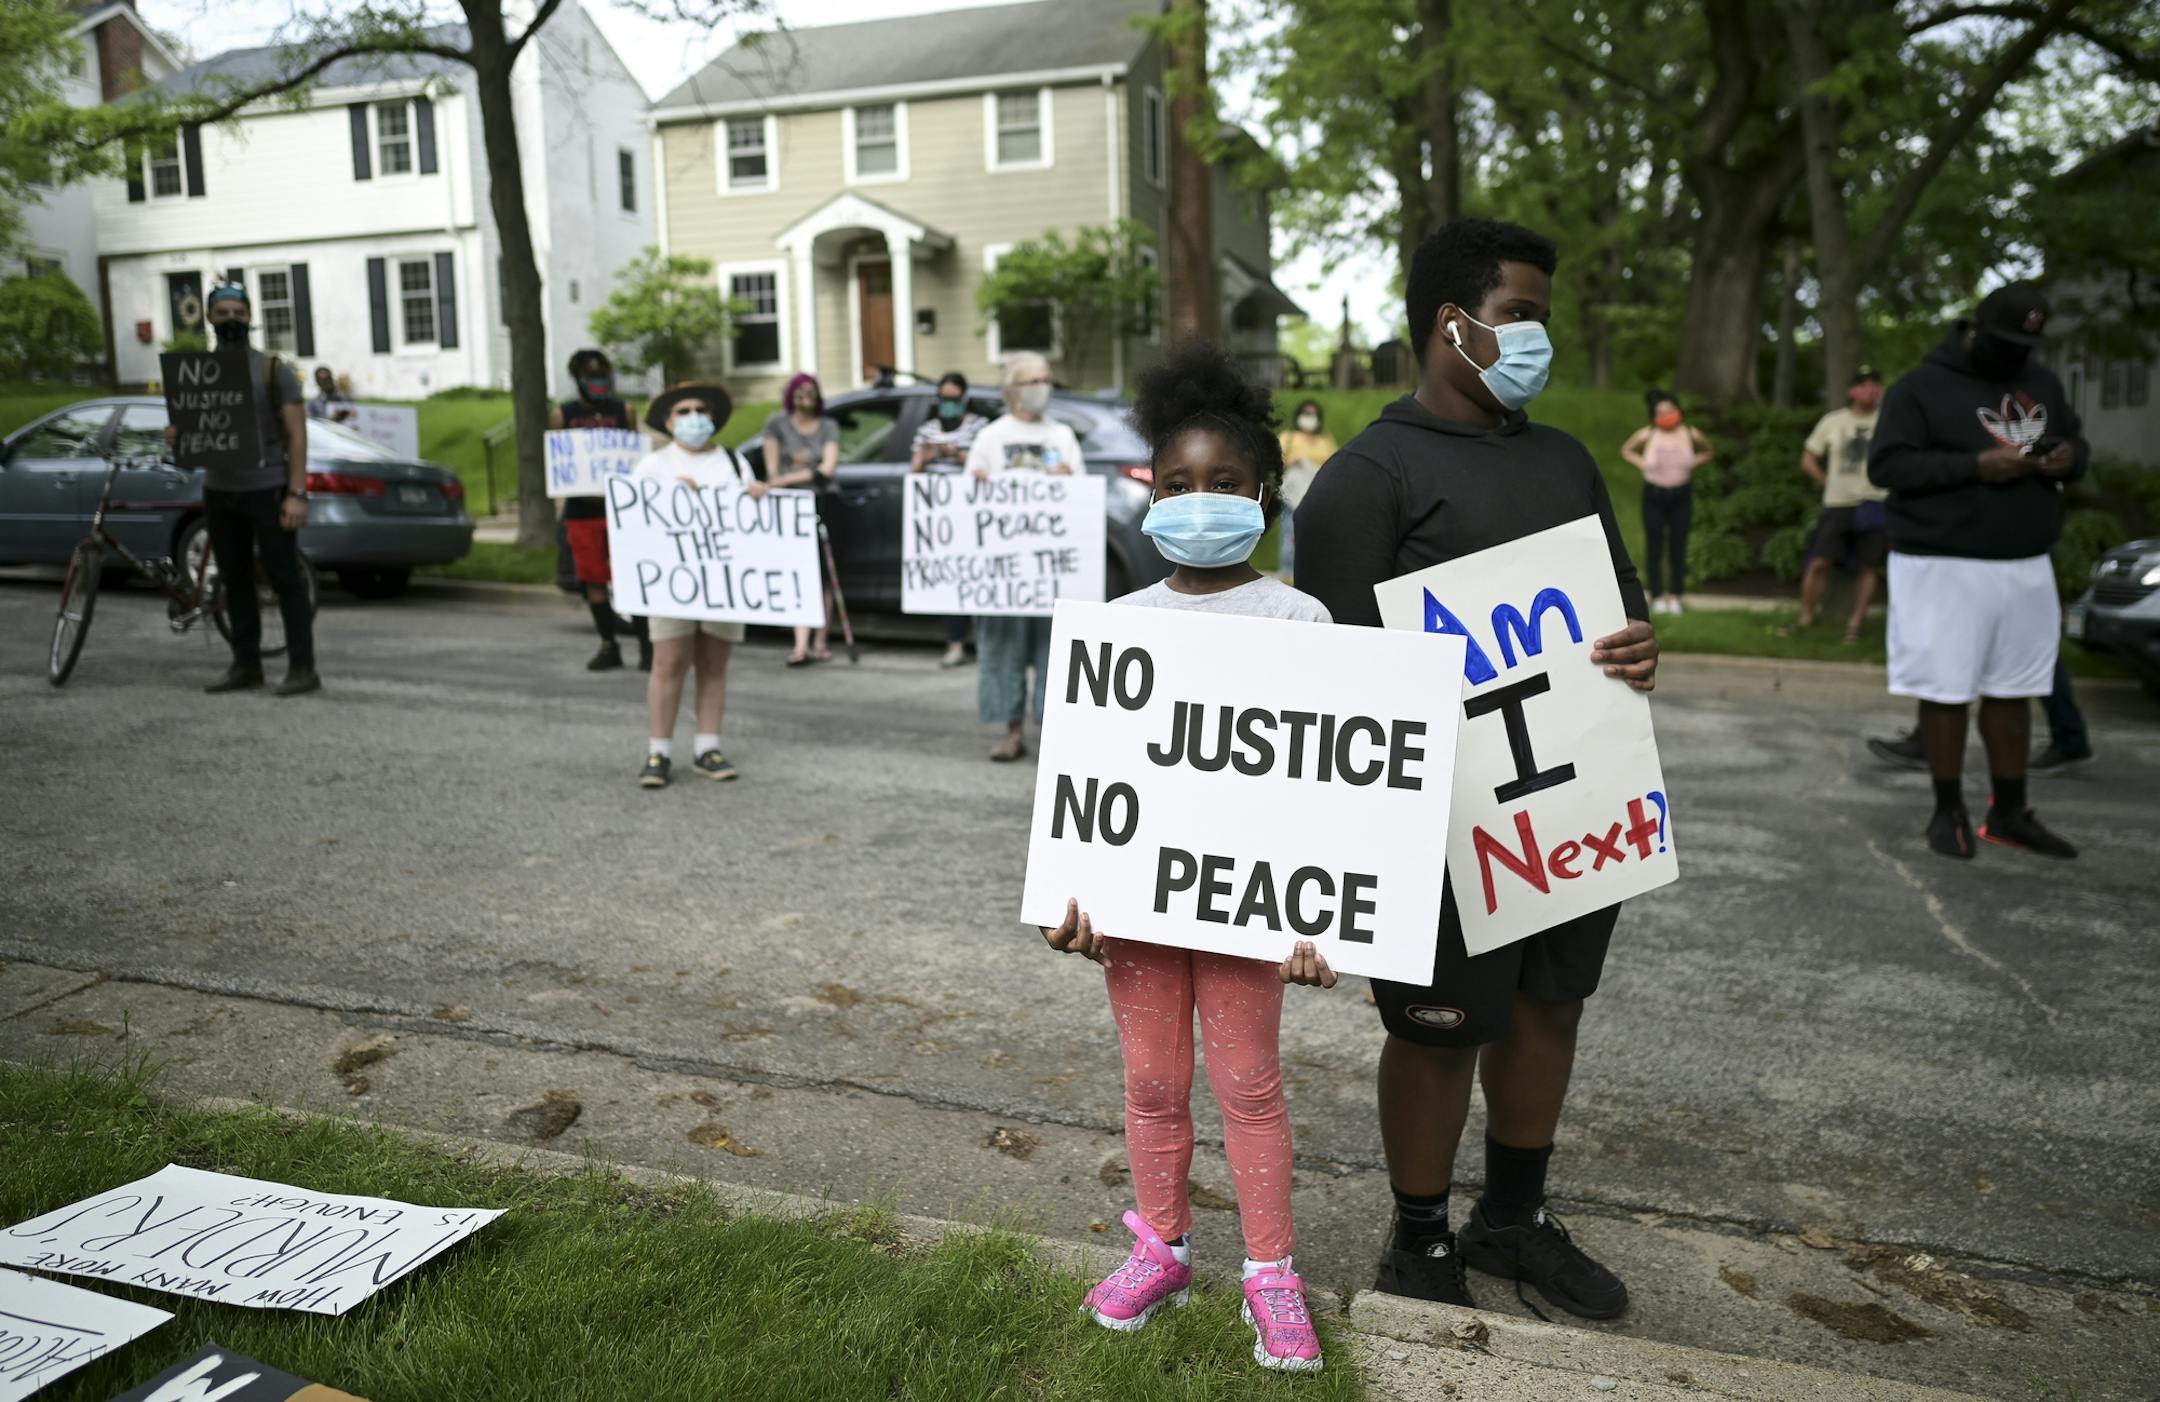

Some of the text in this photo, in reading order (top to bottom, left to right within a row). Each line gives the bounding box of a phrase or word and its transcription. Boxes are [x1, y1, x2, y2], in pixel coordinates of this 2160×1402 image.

[178, 359, 221, 385] NO
[172, 391, 244, 410] JUSTICE
[199, 409, 232, 430] NO
[181, 432, 239, 457] PEACE
[551, 462, 577, 488] NO
[913, 473, 952, 512] NO
[608, 476, 816, 538] PROSECUTE
[666, 529, 734, 563] THE
[914, 514, 954, 554] NO
[636, 559, 802, 612] POLICE!
[904, 547, 1079, 590] PROSECUTE THE
[1065, 639, 1154, 711] NO
[1146, 700, 1427, 791] JUSTICE
[1463, 671, 1577, 804] I
[1050, 774, 1139, 846] NO
[1472, 791, 1667, 915] Next?
[1153, 846, 1378, 944] PEACE
[230, 1193, 477, 1226] IS ENOUGH?
[22, 1252, 343, 1309] HOW MANY MORE
